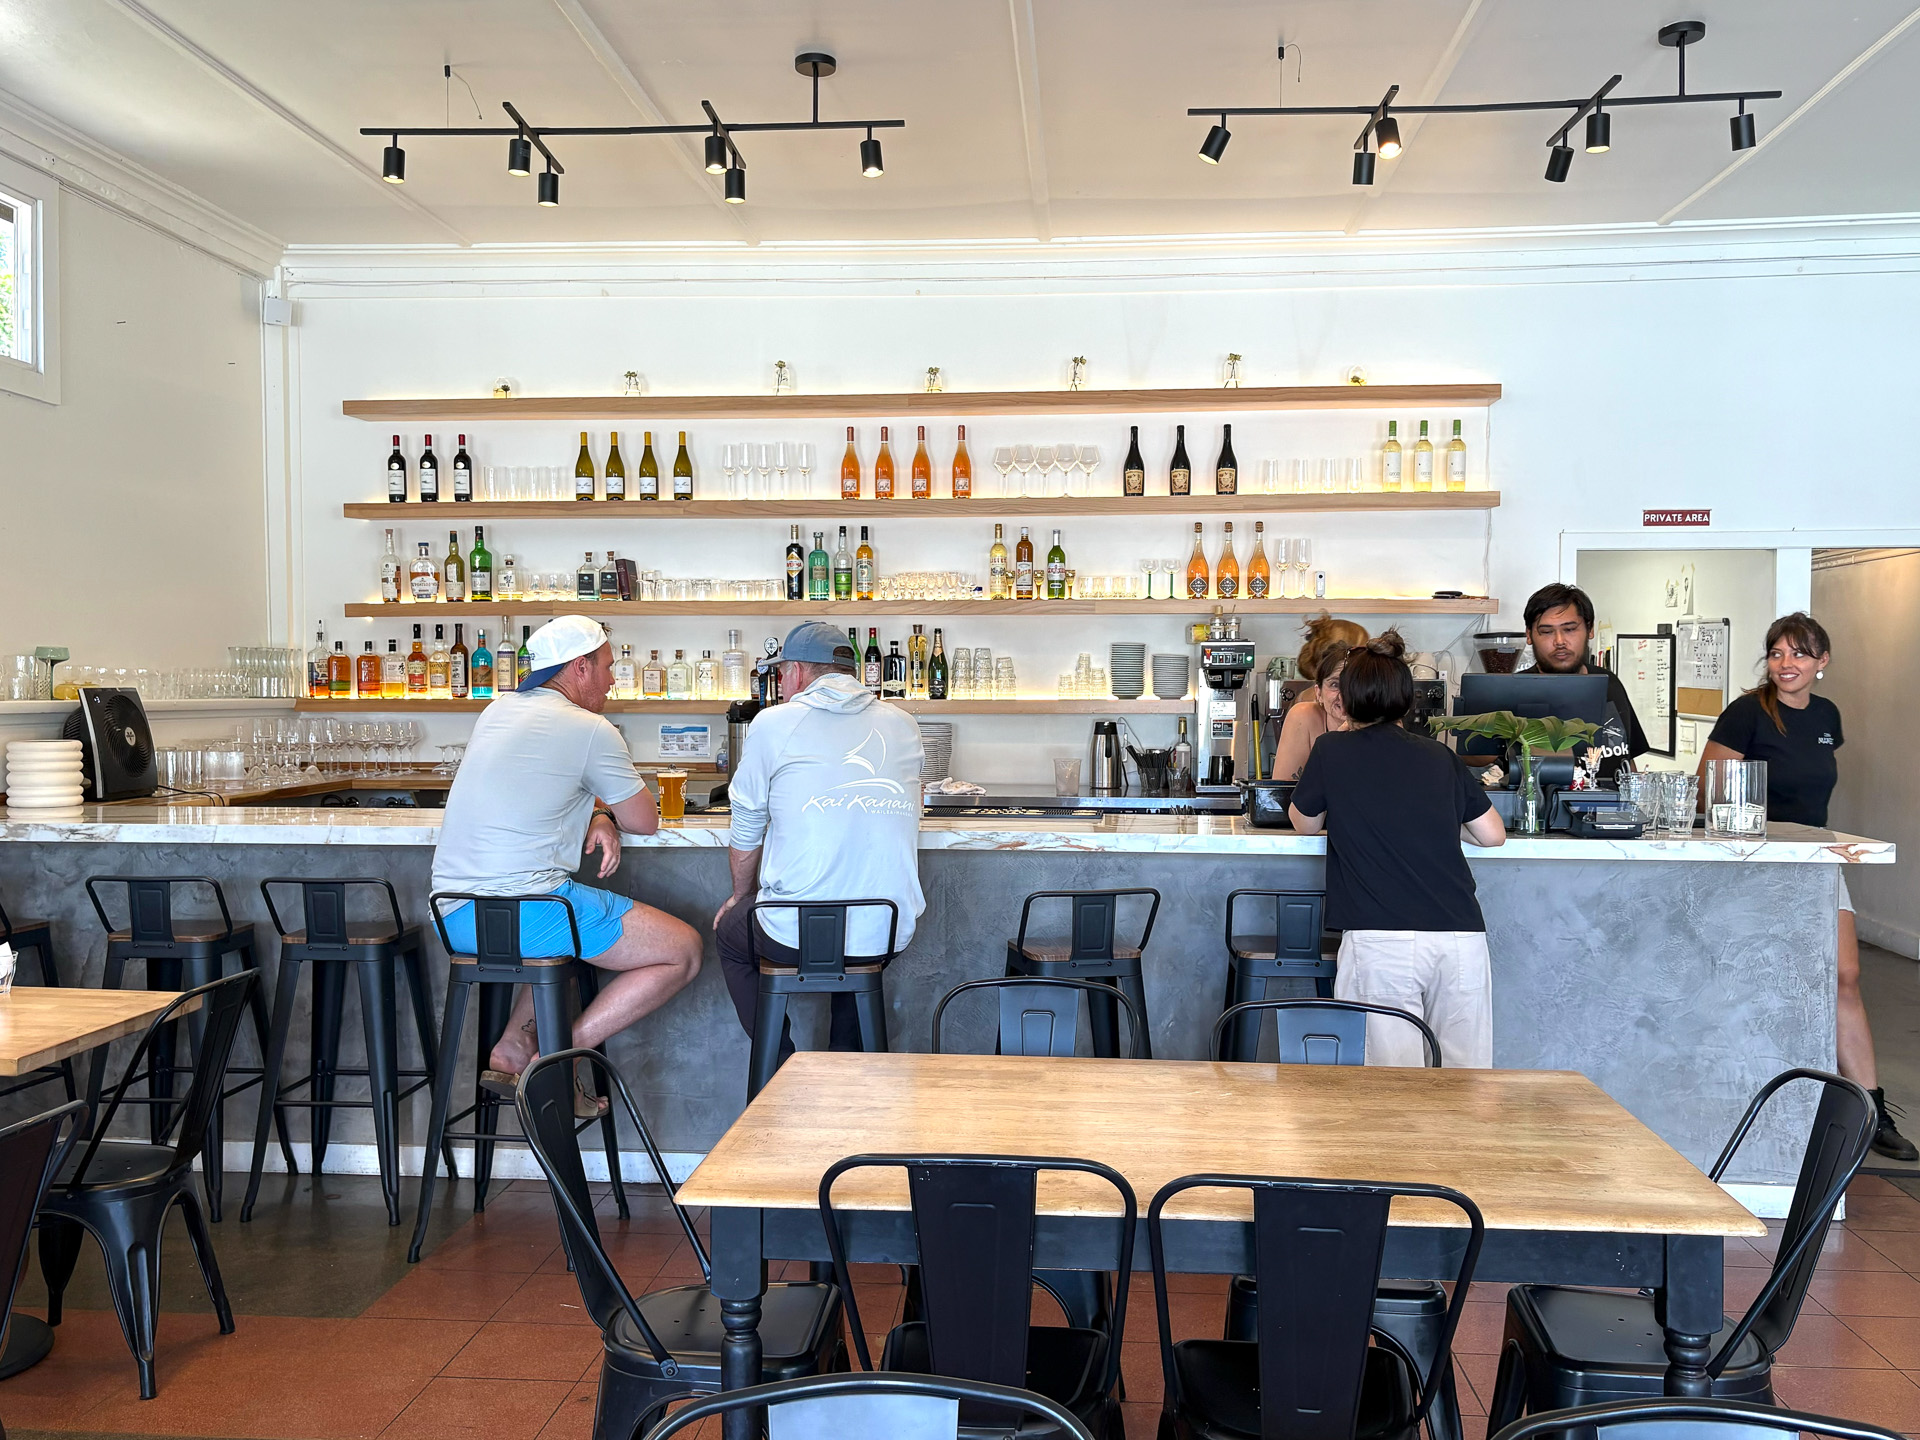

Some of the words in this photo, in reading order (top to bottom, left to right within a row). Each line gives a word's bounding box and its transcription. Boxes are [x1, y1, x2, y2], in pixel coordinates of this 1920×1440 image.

[1644, 513, 1683, 522] PRIVATE
[1685, 513, 1709, 522] AREA
[801, 793, 848, 814] Kai
[847, 794, 916, 814] Kanani
